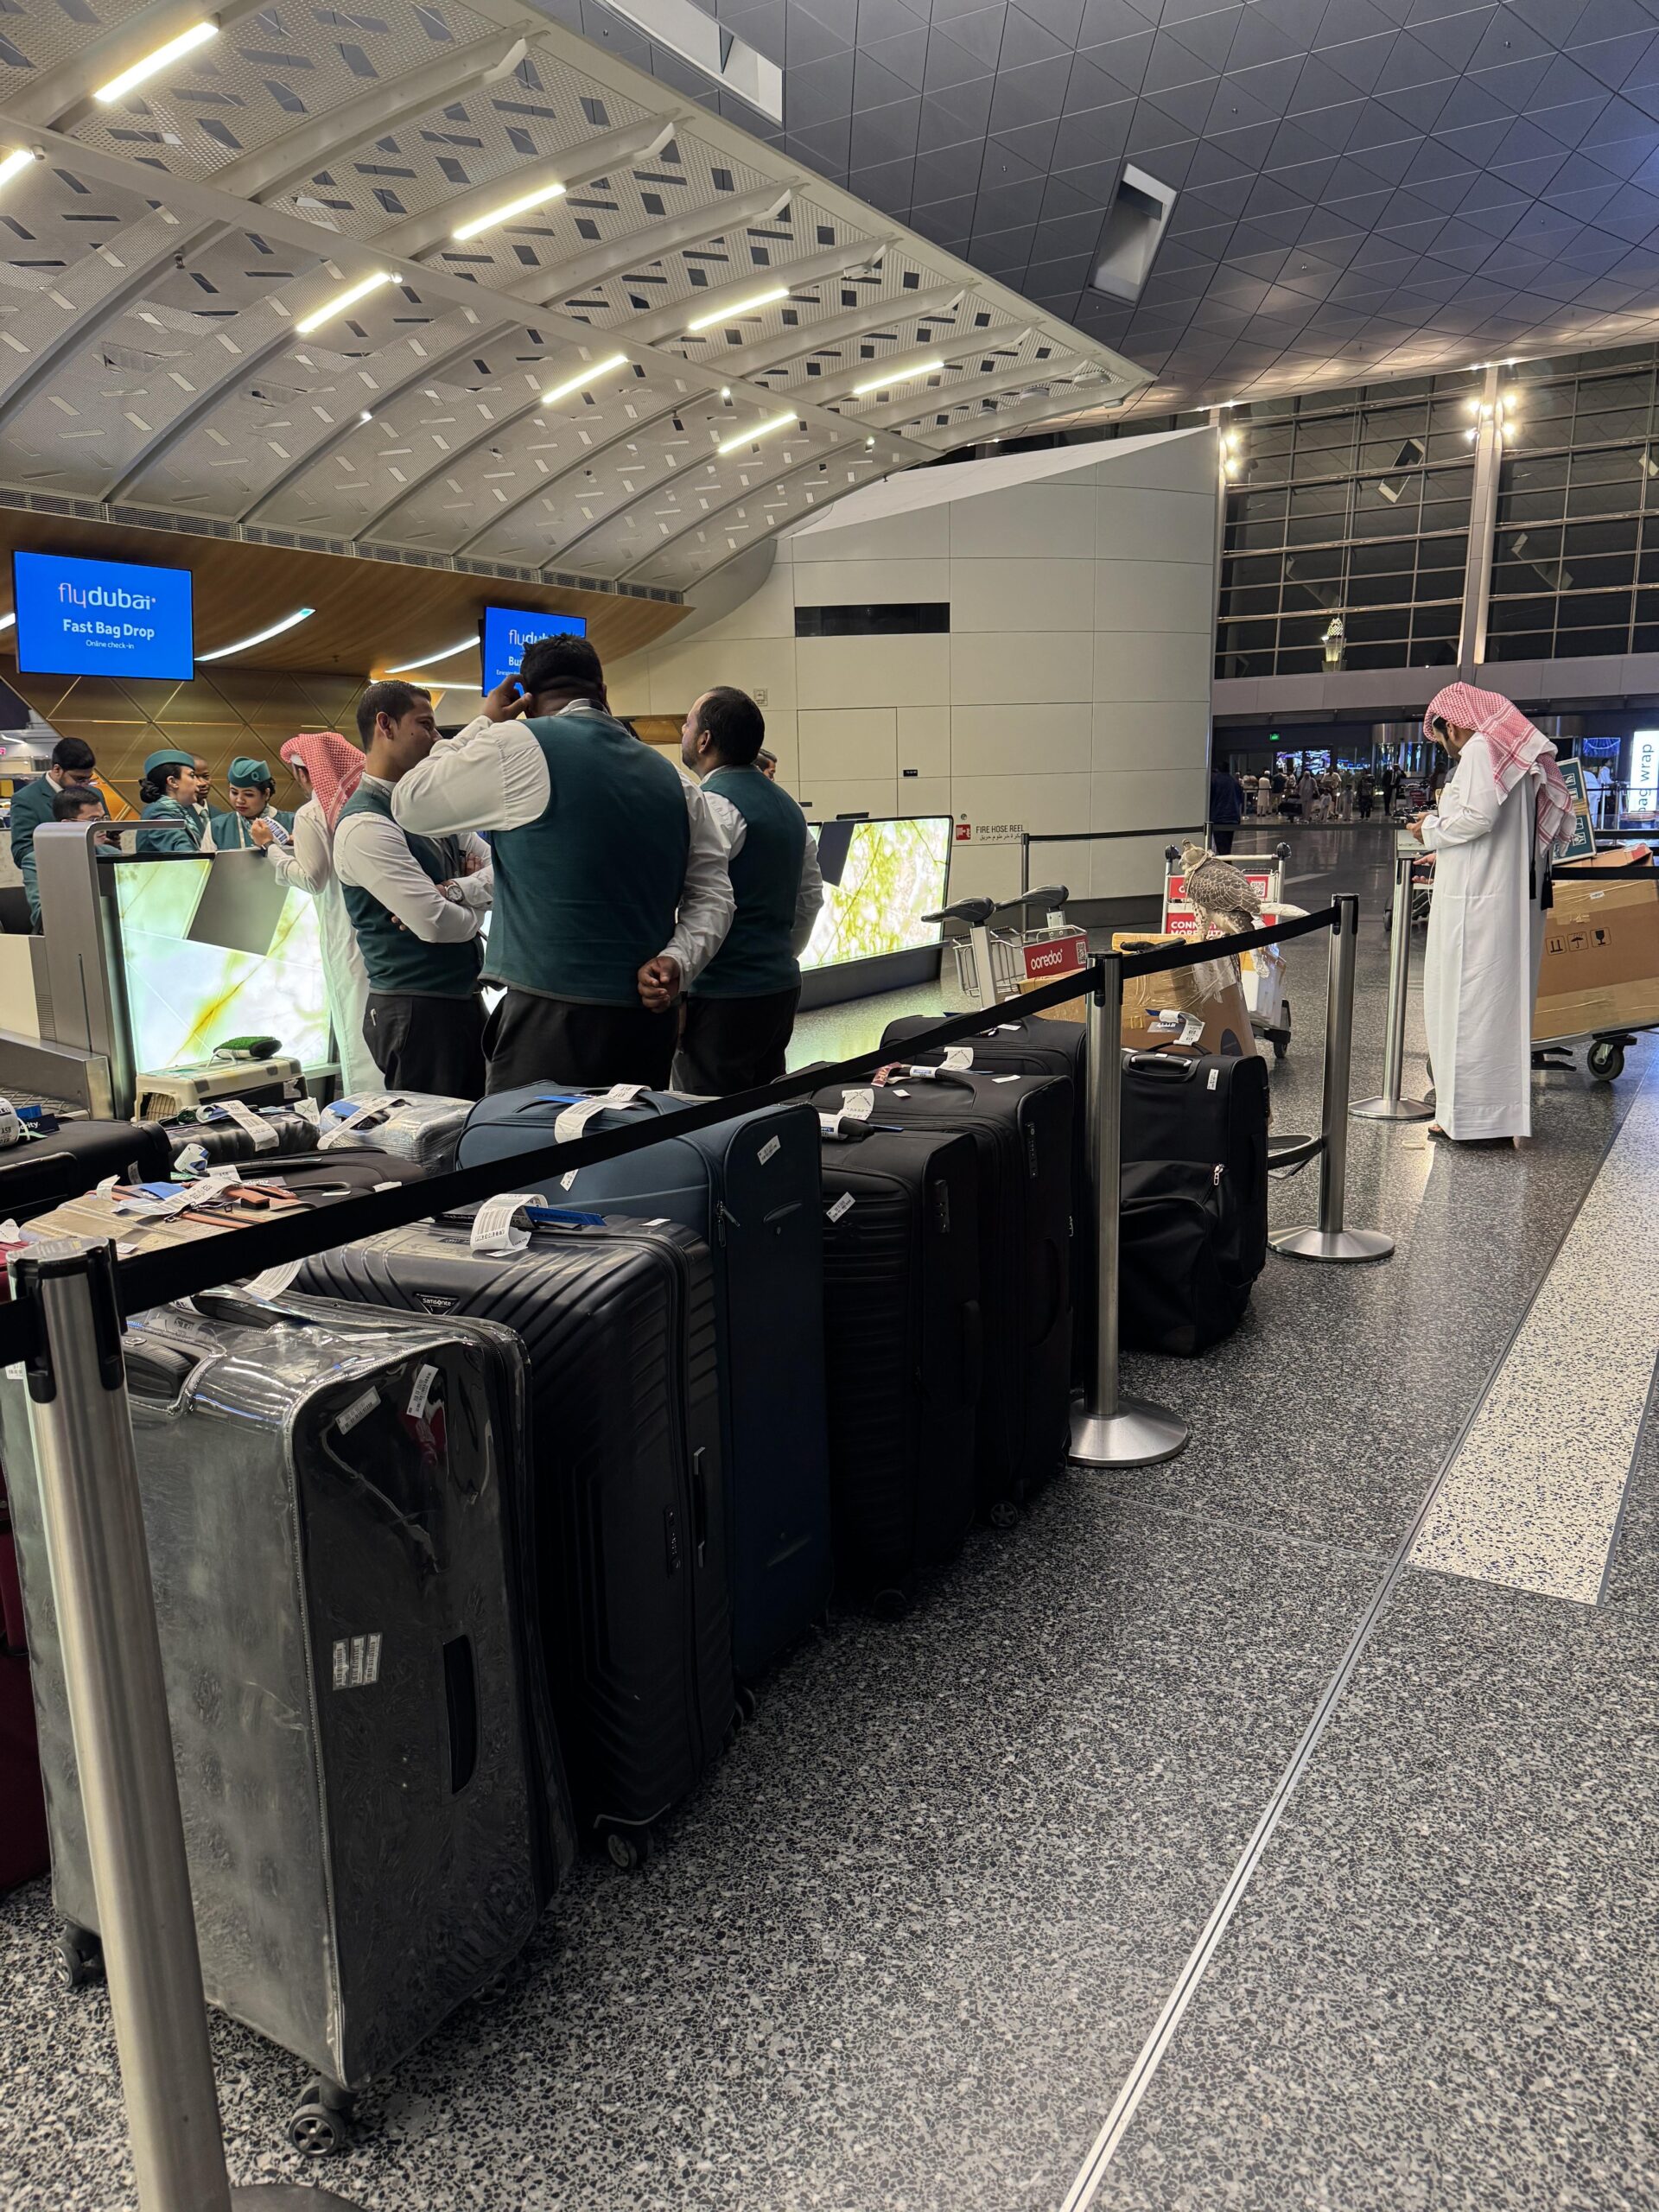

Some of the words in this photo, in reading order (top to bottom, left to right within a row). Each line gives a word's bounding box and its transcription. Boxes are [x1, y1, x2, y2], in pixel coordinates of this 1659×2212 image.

[58, 582, 151, 610] flydubai
[63, 619, 93, 633] Fast
[95, 621, 121, 639] Bag
[123, 623, 155, 640] Drop
[86, 639, 107, 648] Online
[107, 641, 135, 650] check-in
[1641, 743, 1655, 782] wrap
[976, 825, 990, 834] FIRE
[1031, 949, 1063, 970] ooredoo
